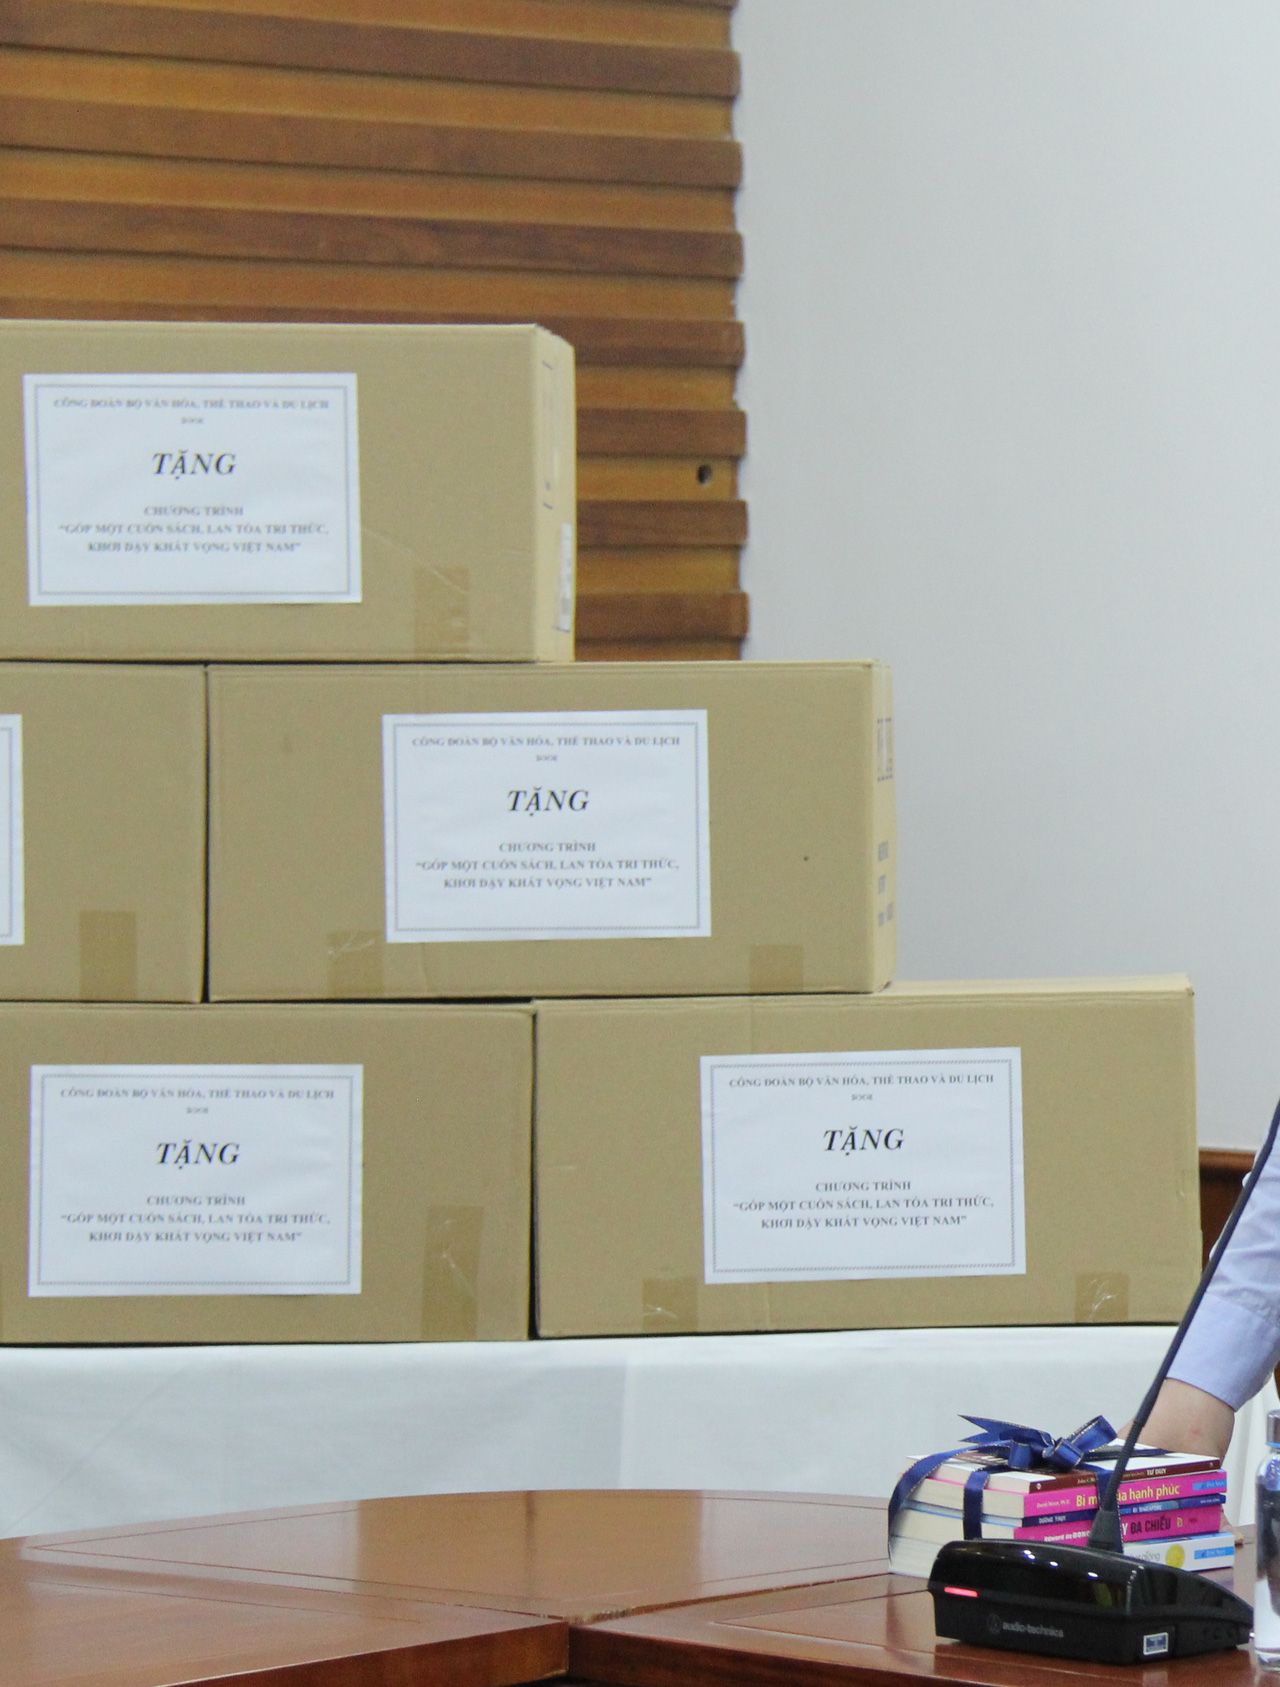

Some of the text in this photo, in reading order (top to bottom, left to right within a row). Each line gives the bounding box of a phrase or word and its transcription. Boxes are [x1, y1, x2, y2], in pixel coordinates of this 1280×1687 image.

[152, 450, 236, 479] TẶNG
[506, 787, 589, 816] TẶNG
[728, 1076, 761, 1088] CÔNG
[763, 1075, 796, 1087] ĐOÀN
[797, 1075, 814, 1088] BỘ
[815, 1075, 839, 1086] VĂN
[897, 1074, 928, 1085] THAO
[930, 1073, 945, 1084] VÀ
[948, 1074, 963, 1084] DU
[966, 1073, 993, 1085] LỊCH
[823, 1125, 904, 1155] TẶNG
[156, 1140, 239, 1169] TẶNG
[814, 1179, 911, 1192] CHƯƠNG TRÌNH
[767, 1199, 795, 1212] MỘT
[875, 1198, 900, 1209] LAN
[933, 1198, 952, 1208] TRI
[824, 1216, 858, 1228] KHÁT
[862, 1216, 897, 1228] VỌNG
[901, 1215, 928, 1228] VIỆT
[1129, 1486, 1153, 1502] hạnh
[1156, 1483, 1180, 1499] phúc
